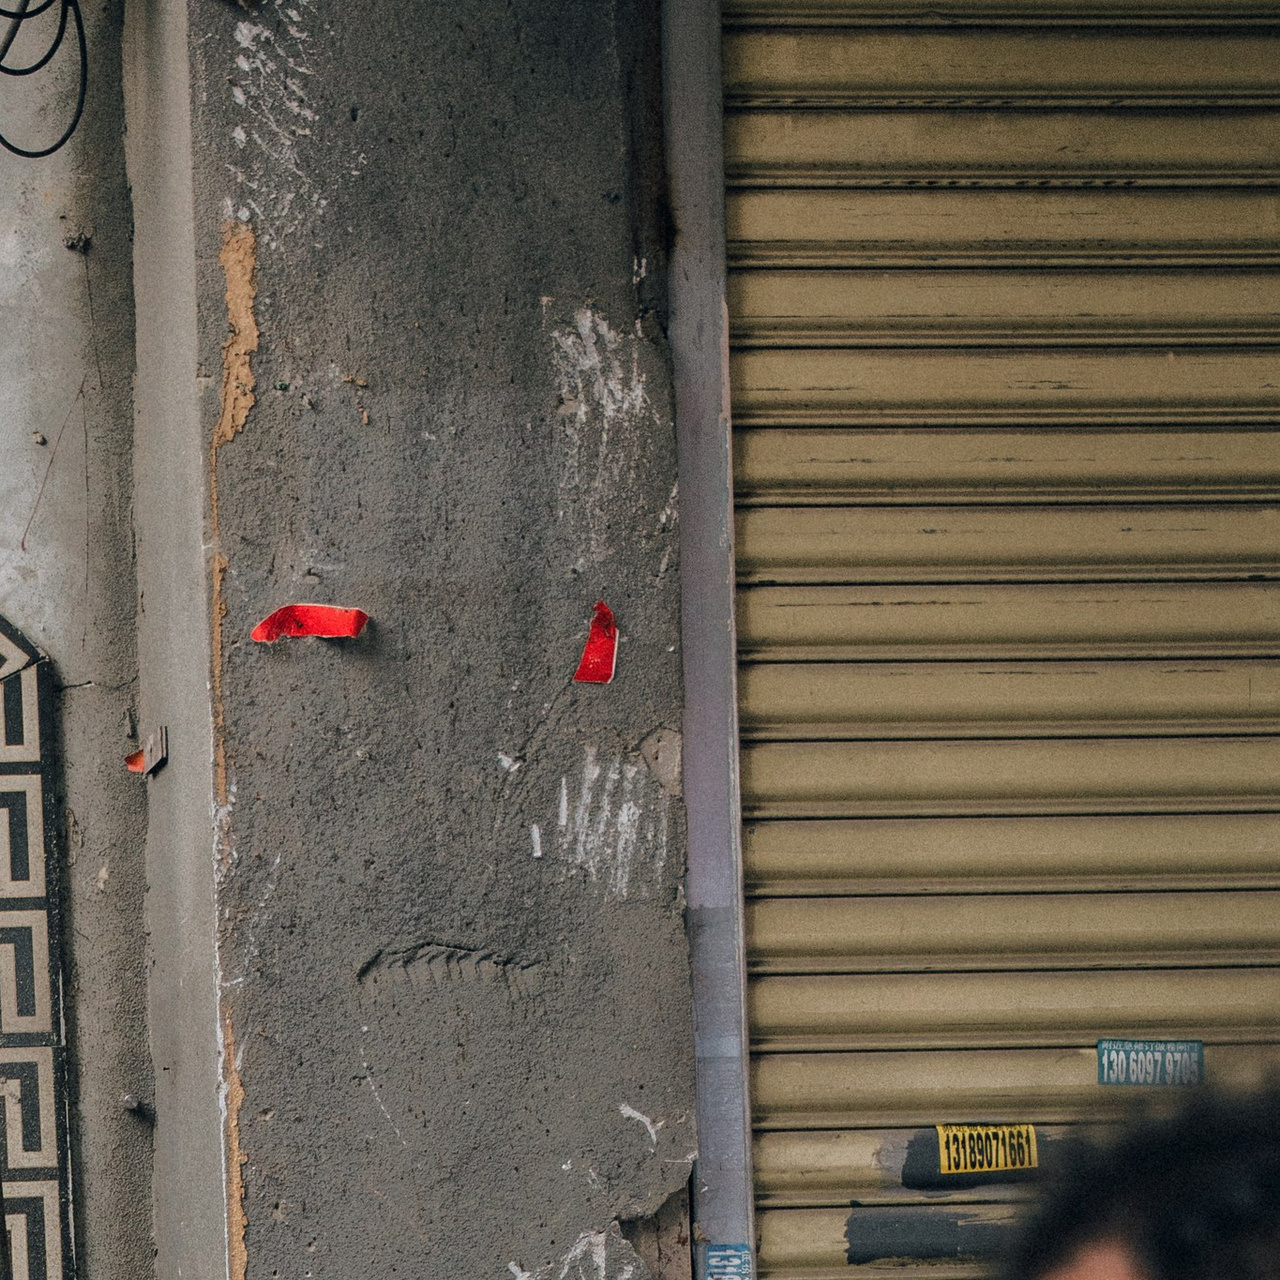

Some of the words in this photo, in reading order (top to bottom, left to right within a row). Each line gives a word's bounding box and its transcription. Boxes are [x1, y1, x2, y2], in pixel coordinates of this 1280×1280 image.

[1102, 1049, 1126, 1083] 130
[1129, 1050, 1162, 1084] 6097
[945, 1128, 1032, 1171] 13189071661
